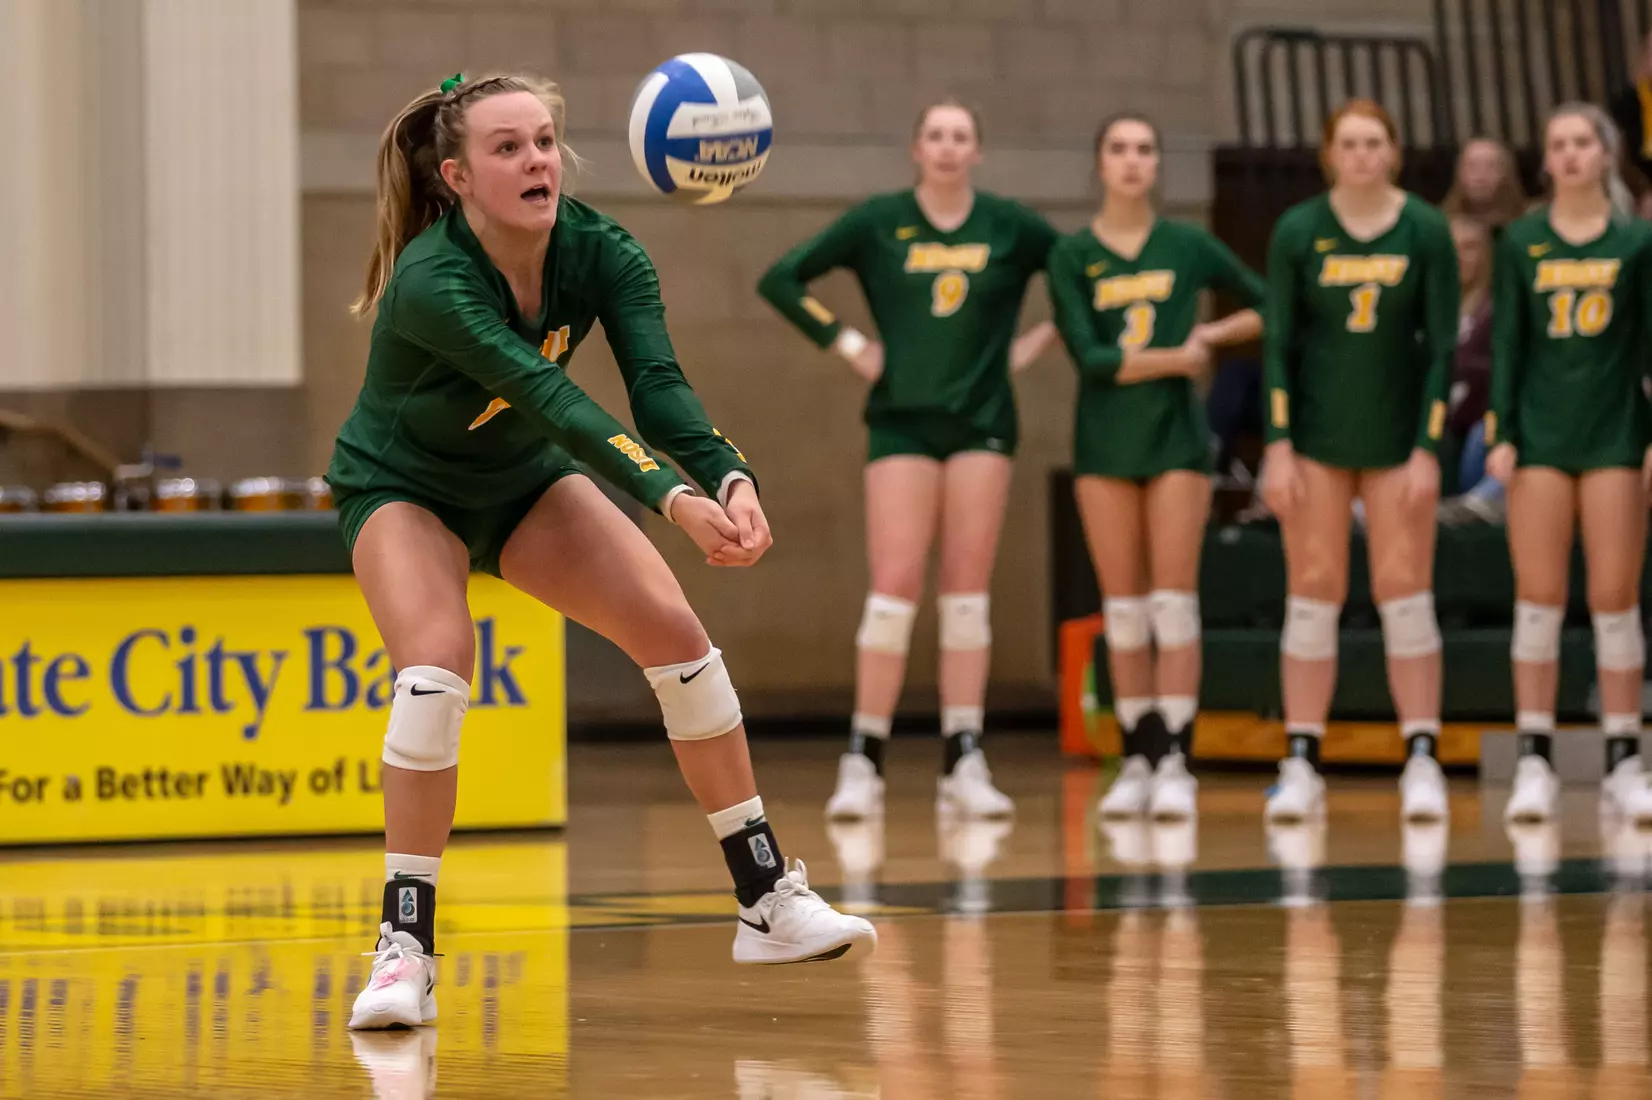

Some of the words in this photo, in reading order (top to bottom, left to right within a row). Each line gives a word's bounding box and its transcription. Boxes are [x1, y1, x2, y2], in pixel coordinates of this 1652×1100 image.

[688, 160, 762, 187] molten
[931, 268, 970, 318] 9
[1345, 282, 1382, 333] 1
[1546, 286, 1614, 339] 10
[109, 625, 288, 740] City
[302, 615, 530, 711] Bak
[64, 774, 82, 801] a
[96, 765, 209, 800] Better
[221, 761, 298, 806] Way
[309, 757, 346, 796] of
